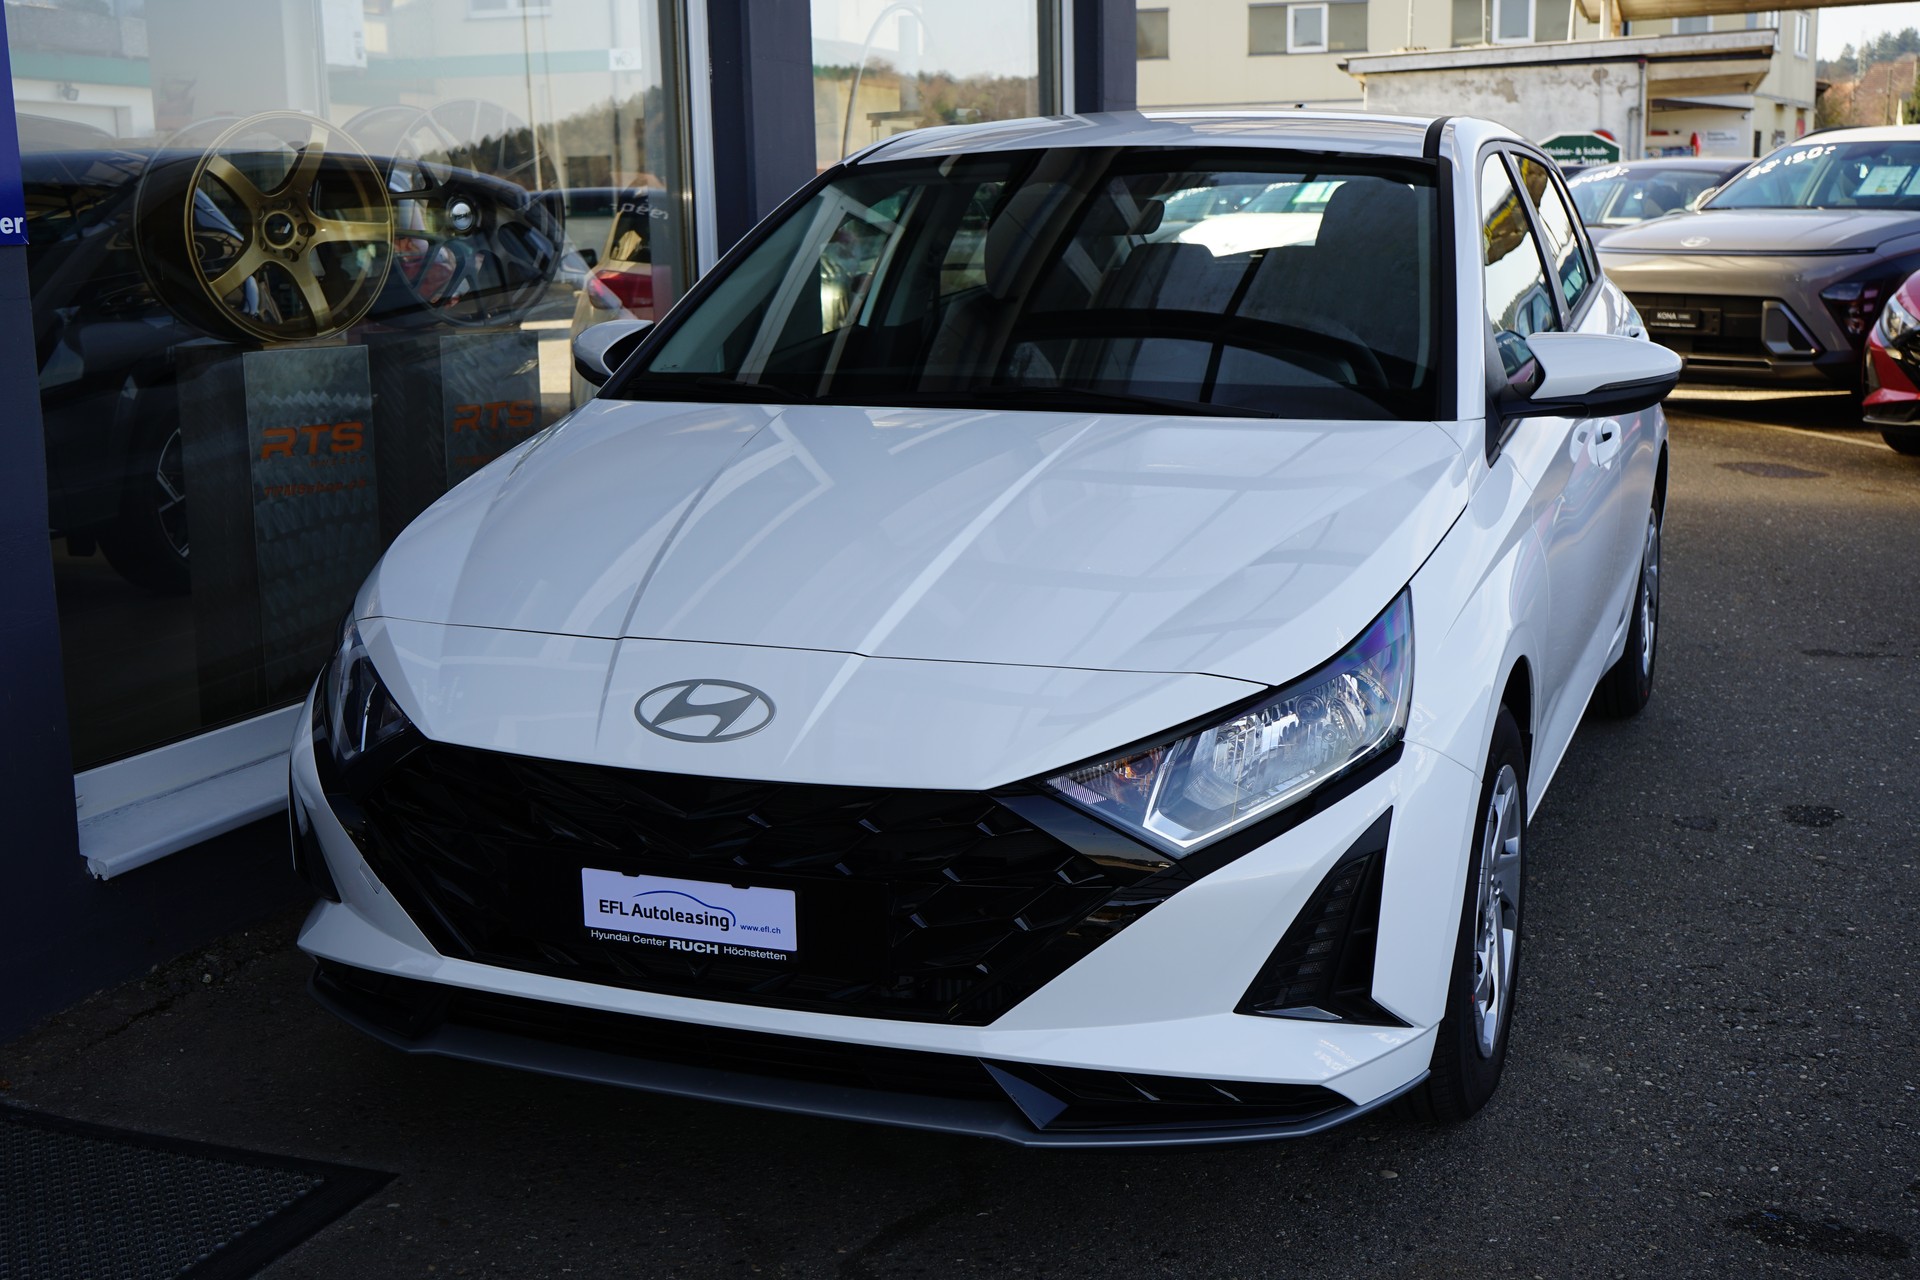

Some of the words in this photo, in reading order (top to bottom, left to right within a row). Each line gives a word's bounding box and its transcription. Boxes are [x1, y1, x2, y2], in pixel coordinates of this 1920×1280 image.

[0, 216, 24, 235] er
[1656, 311, 1678, 321] KONA
[453, 400, 534, 432] RTS
[260, 421, 365, 460] RTS
[599, 898, 629, 916] EFL
[632, 903, 730, 932] Autoleasing
[740, 923, 782, 935] www.efl.ch
[590, 929, 630, 942] Hyundai
[632, 934, 667, 947] Center
[669, 939, 719, 955] RUCH
[723, 945, 787, 961] Höchstetten
